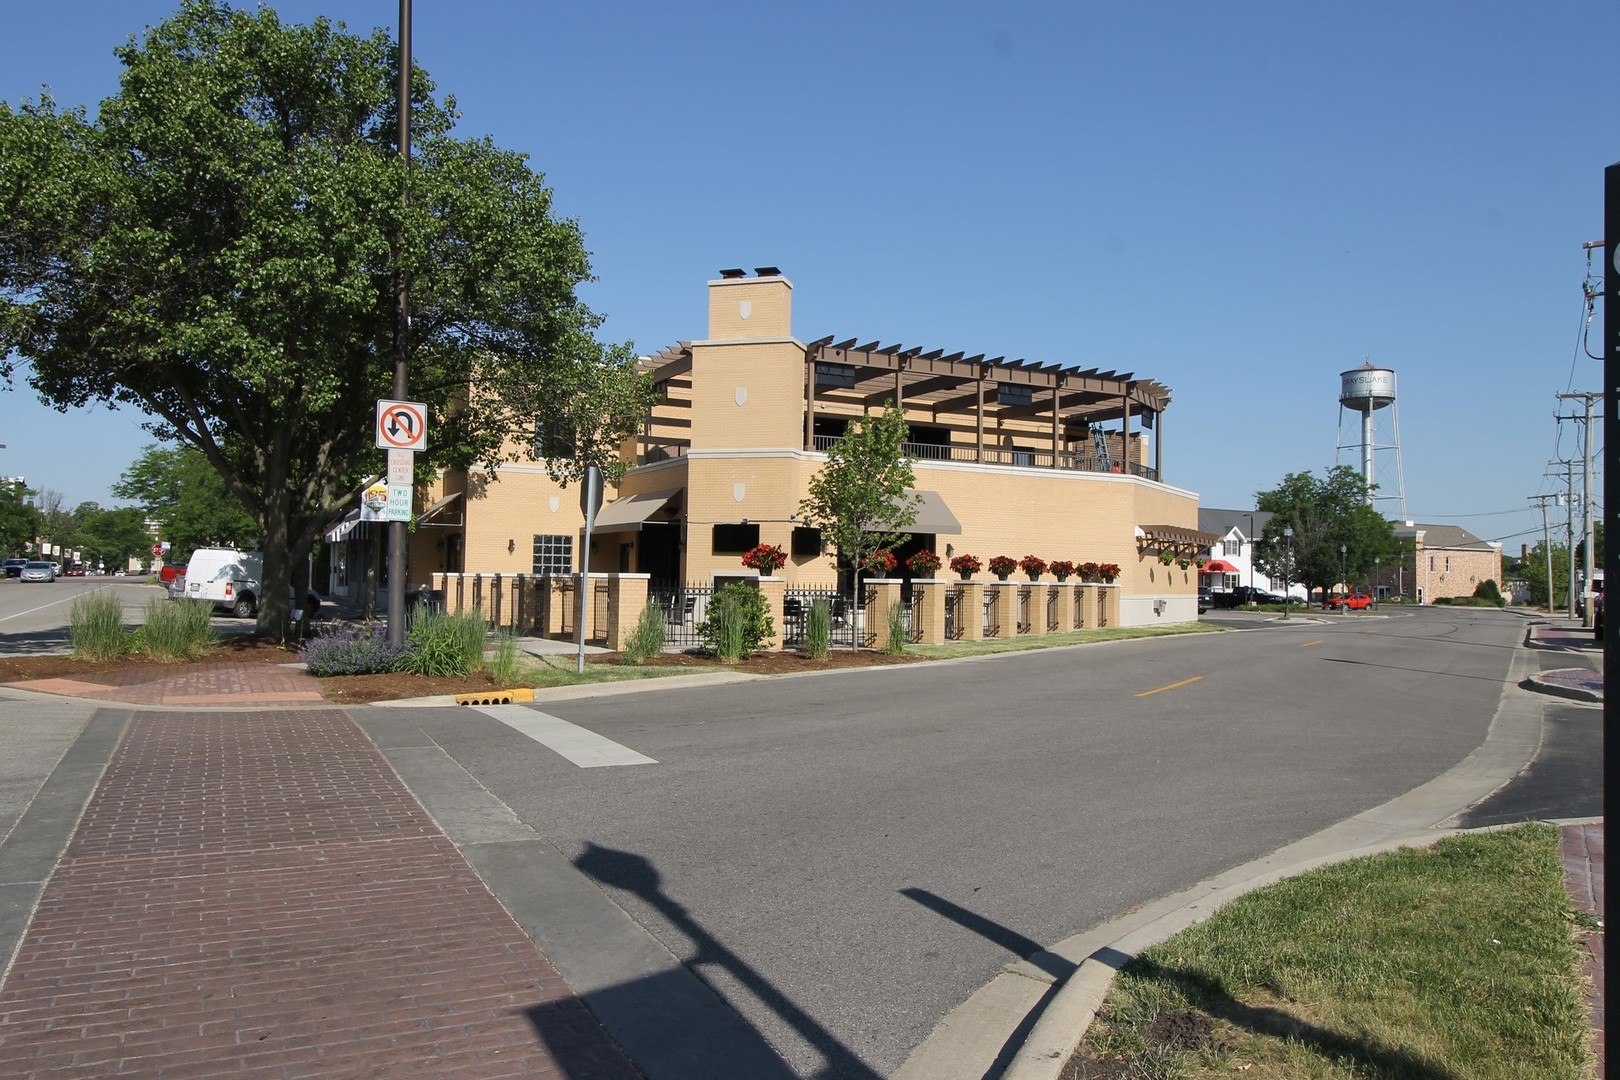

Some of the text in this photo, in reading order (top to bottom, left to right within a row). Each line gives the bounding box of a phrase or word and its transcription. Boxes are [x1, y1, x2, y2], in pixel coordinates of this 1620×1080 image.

[393, 489, 407, 497] TWO
[390, 499, 409, 507] HOUR
[389, 508, 409, 516] PARKING
